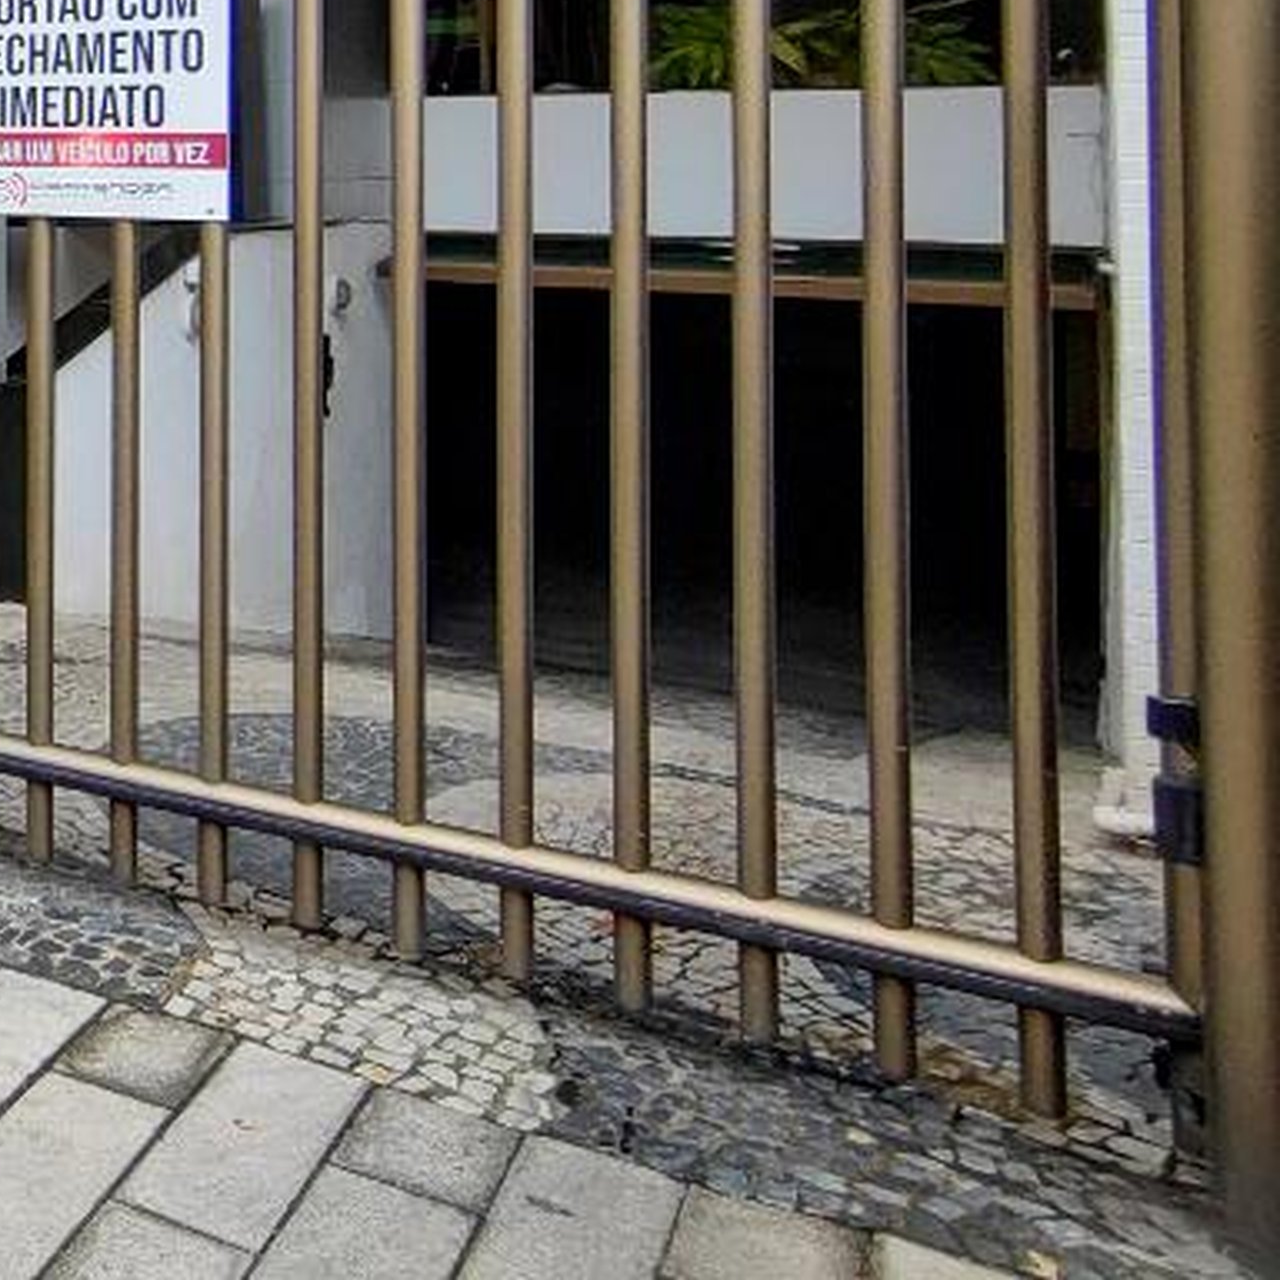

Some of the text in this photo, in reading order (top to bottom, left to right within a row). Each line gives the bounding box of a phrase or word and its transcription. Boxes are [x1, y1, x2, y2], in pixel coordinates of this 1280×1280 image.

[0, 85, 165, 128] IMEDIATO
[25, 139, 53, 163] UM
[132, 141, 169, 164] POR
[173, 141, 210, 165] VEZ
